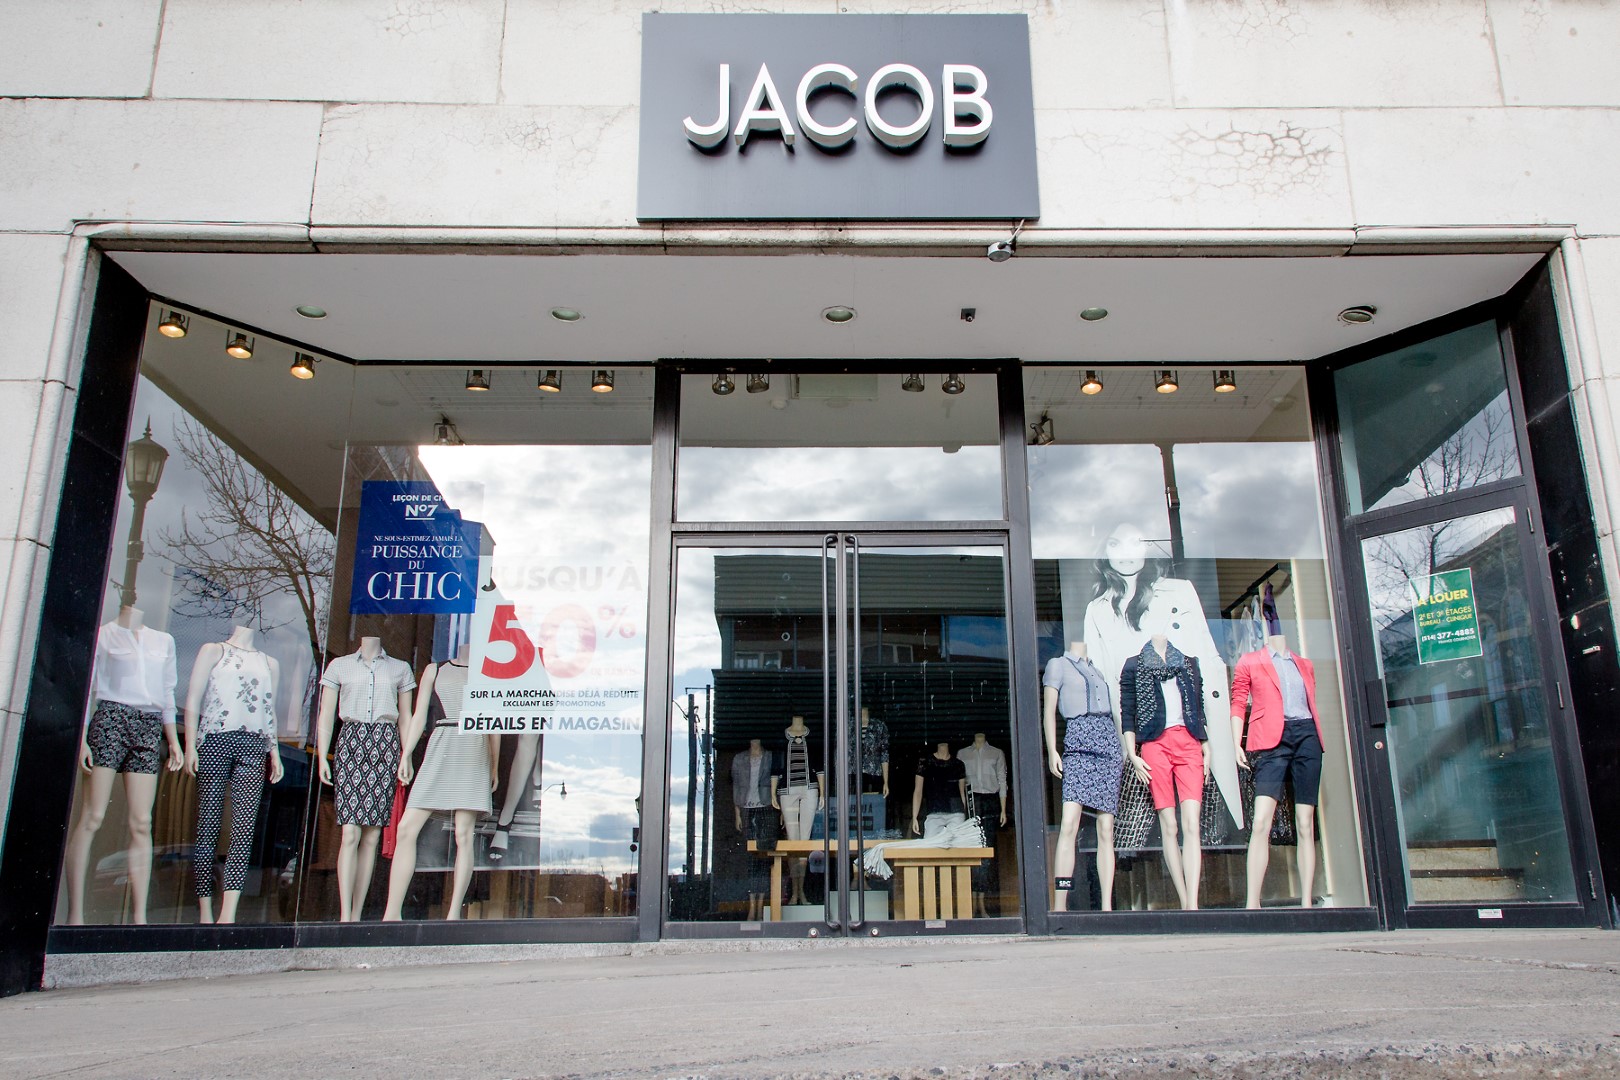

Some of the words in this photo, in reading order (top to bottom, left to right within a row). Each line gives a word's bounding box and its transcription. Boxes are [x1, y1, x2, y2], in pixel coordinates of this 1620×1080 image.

[682, 62, 993, 146] JACOB
[392, 494, 419, 503] LEÇON
[371, 545, 463, 559] PUISSANCE
[408, 560, 425, 570] DU
[367, 571, 462, 601] CHIC
[1429, 589, 1468, 604] LOUER
[1446, 606, 1472, 616] ÉTAGES
[470, 690, 488, 699] SUR
[491, 690, 503, 698] LA
[506, 689, 575, 698] MARCHANDISE
[578, 687, 600, 698] DÉJÀ
[603, 688, 639, 699] RÉDUITE
[463, 713, 526, 731] DÉTAILS
[531, 717, 553, 731] EN
